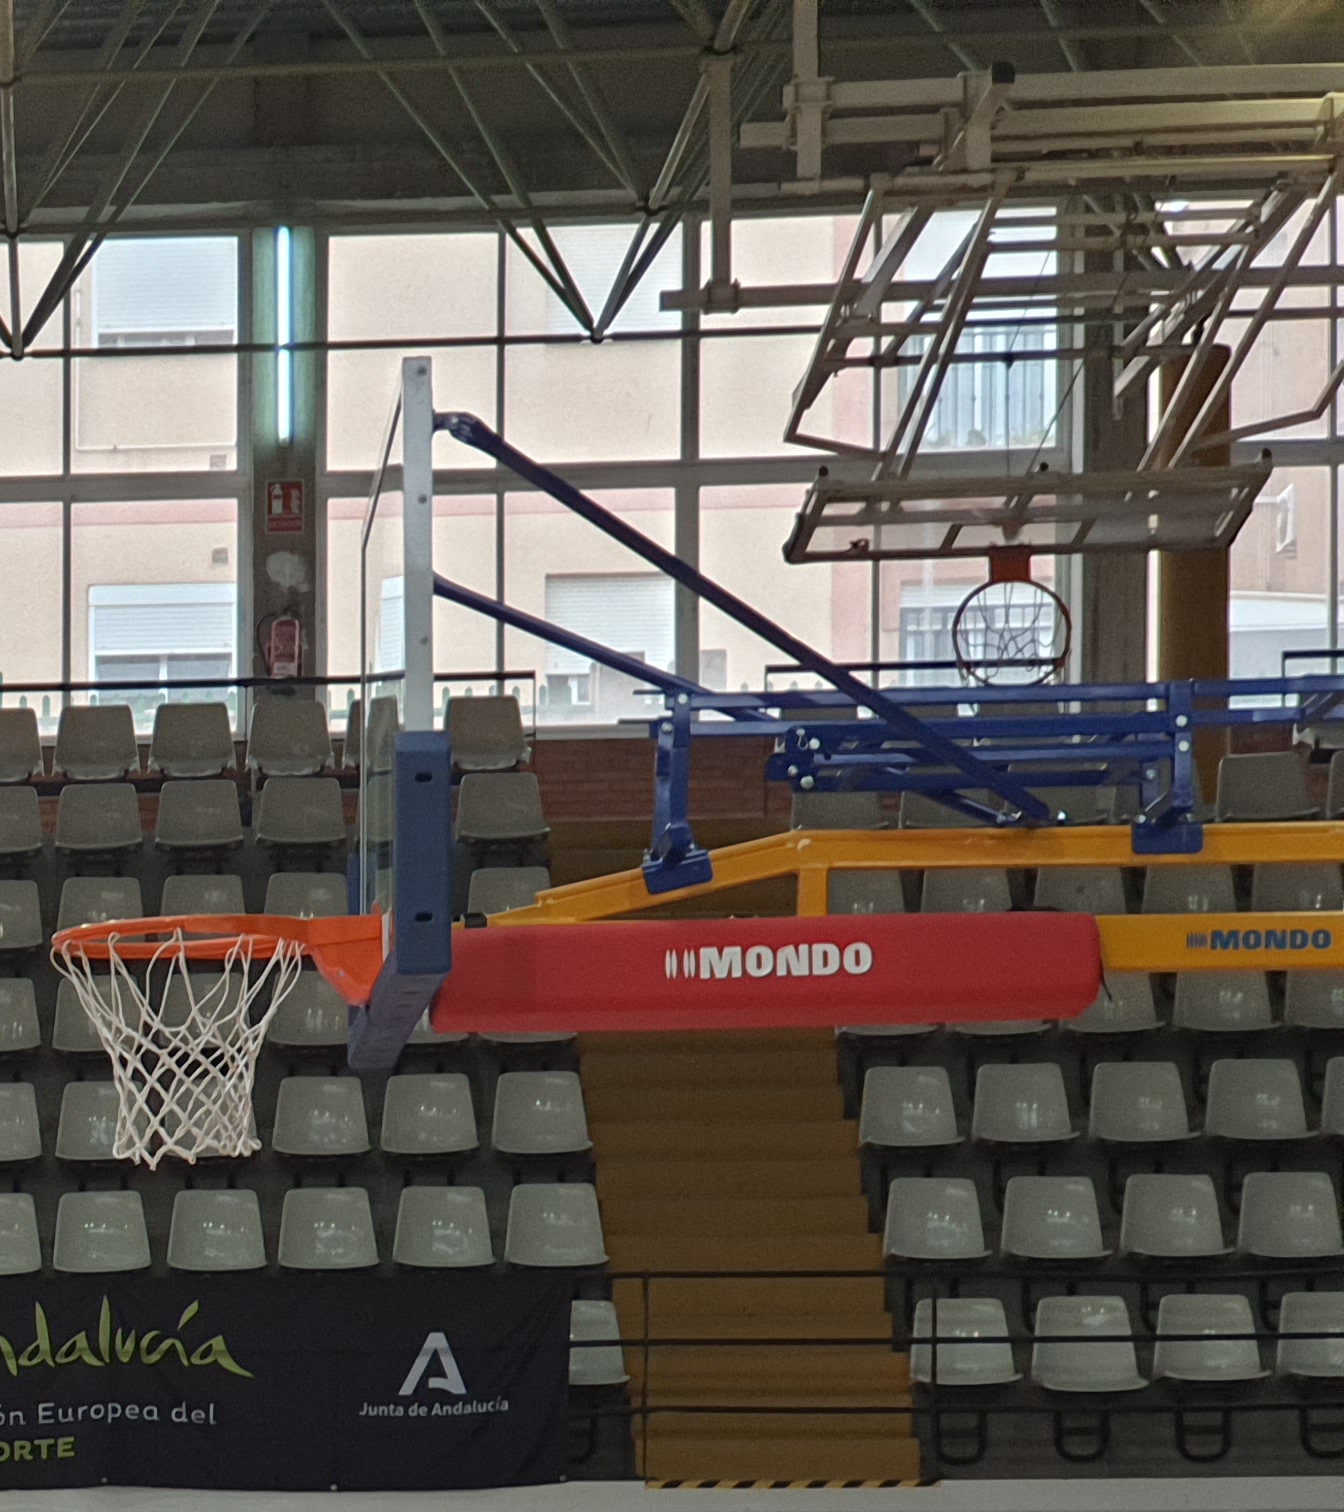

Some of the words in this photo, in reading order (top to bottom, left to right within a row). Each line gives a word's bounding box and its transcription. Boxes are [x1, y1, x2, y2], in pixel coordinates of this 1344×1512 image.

[1209, 927, 1333, 953] MONDO
[700, 942, 874, 981] MONDO
[38, 1400, 160, 1429] Europea
[171, 1402, 217, 1425] del
[359, 1402, 404, 1417] Junta
[408, 1402, 428, 1417] de
[431, 1396, 509, 1417] Andalucía
